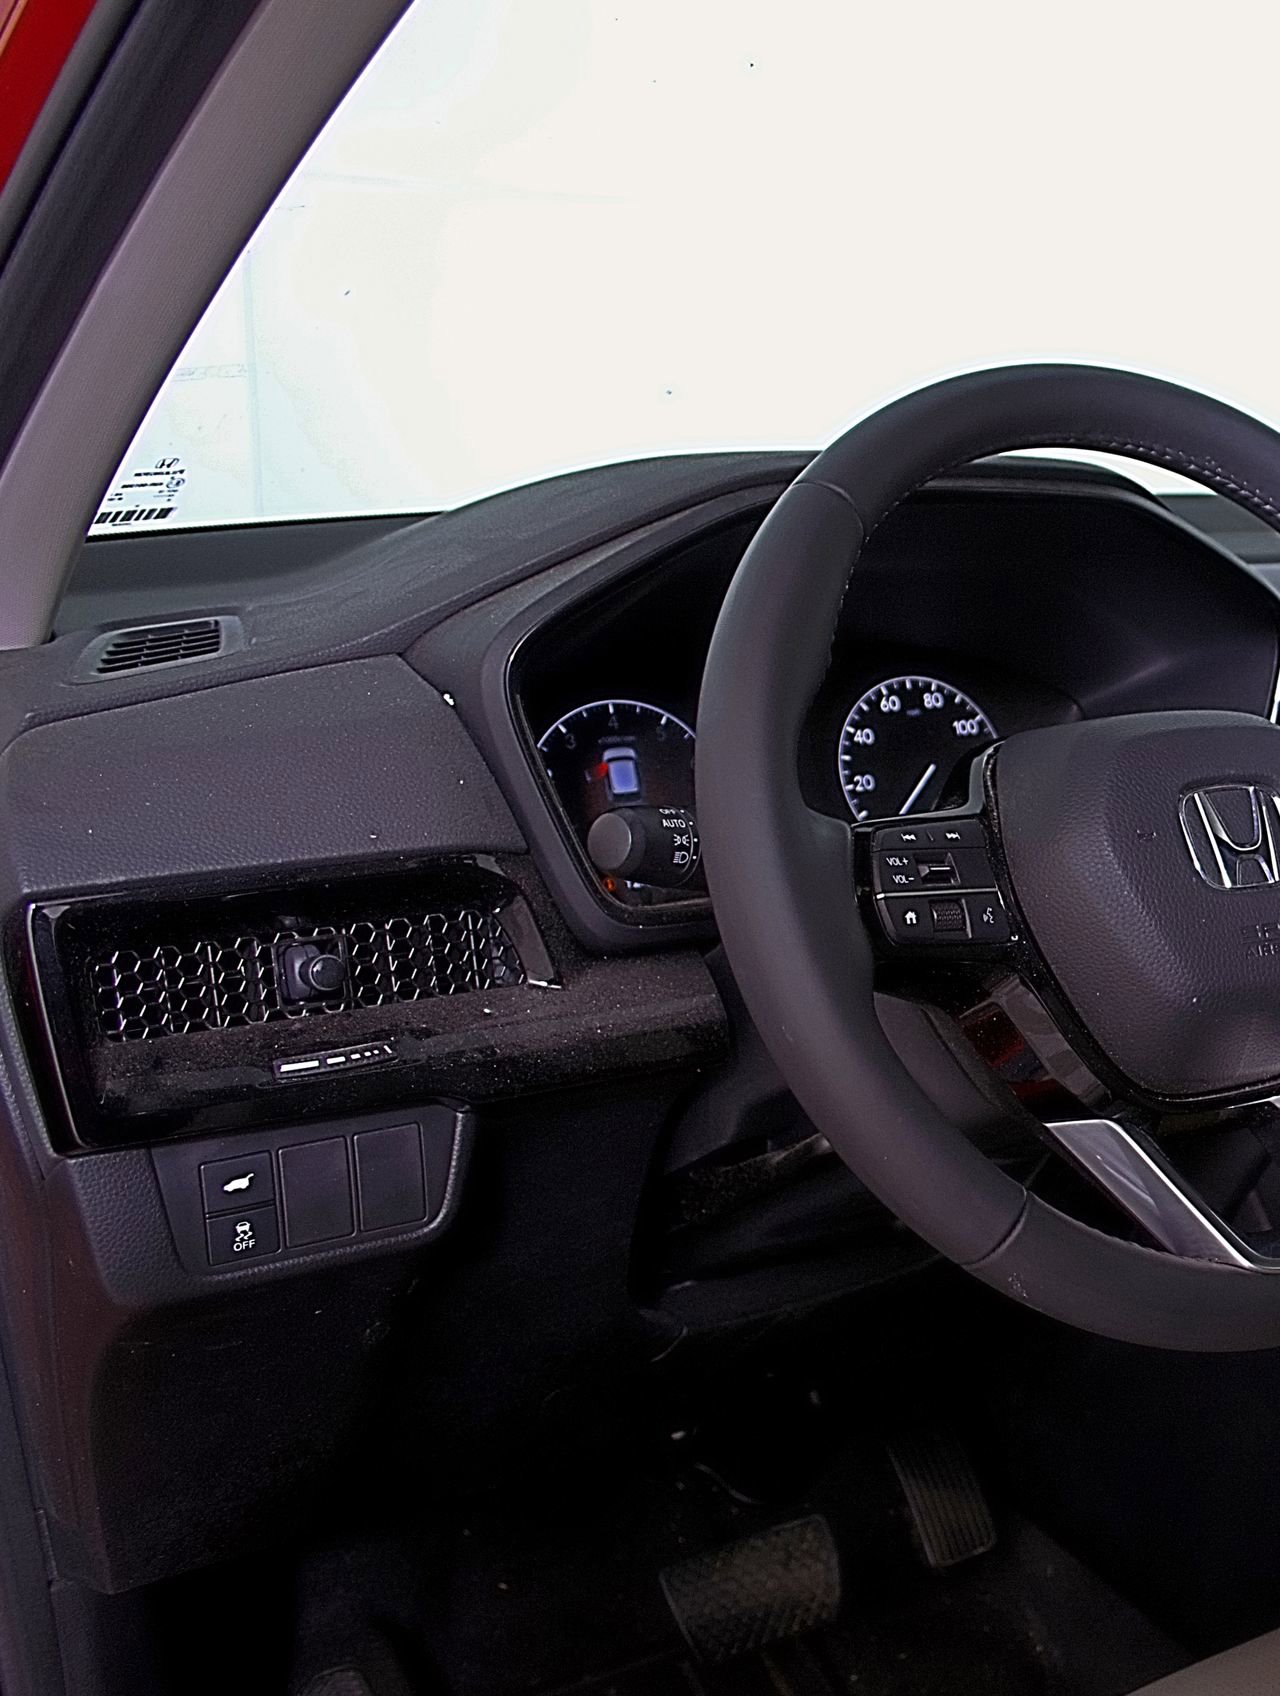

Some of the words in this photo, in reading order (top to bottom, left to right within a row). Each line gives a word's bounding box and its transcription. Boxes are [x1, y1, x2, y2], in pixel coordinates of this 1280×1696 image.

[880, 695, 901, 713] 60
[923, 692, 944, 709] 80
[608, 716, 619, 730] 4
[952, 719, 979, 736] 100
[565, 735, 577, 750] 3
[853, 728, 875, 745] 40
[853, 774, 875, 792] 20
[661, 818, 687, 829] AUTO
[233, 1238, 256, 1251] OFF
